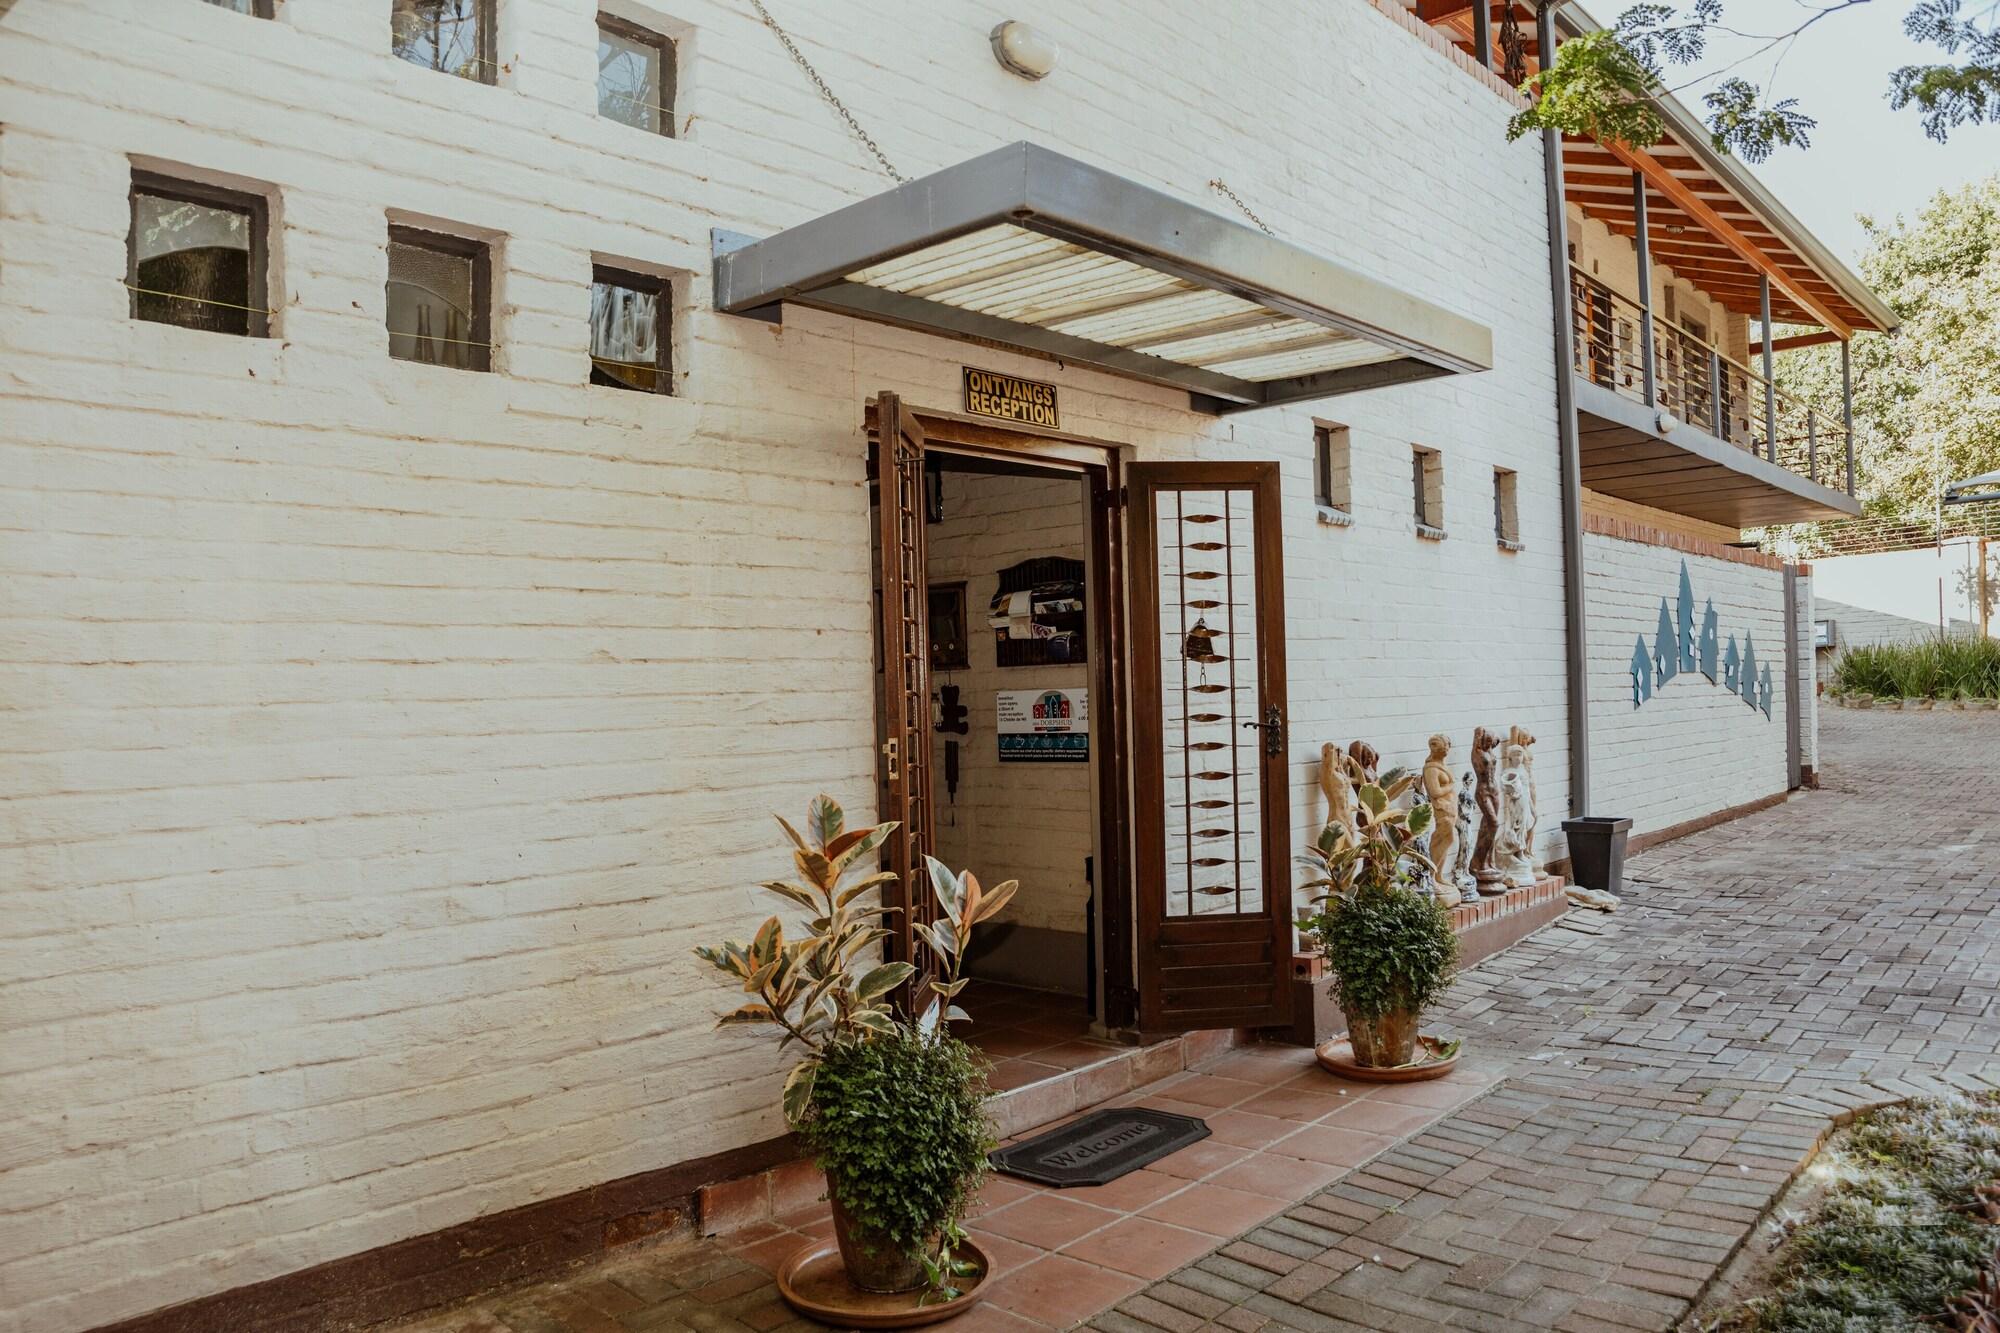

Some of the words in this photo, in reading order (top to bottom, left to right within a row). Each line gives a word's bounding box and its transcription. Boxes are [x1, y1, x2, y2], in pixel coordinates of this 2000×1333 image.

[970, 372, 1053, 407] ONTVANGS
[970, 391, 1056, 426] RECEPTION
[1043, 1120, 1148, 1168] Welcome
